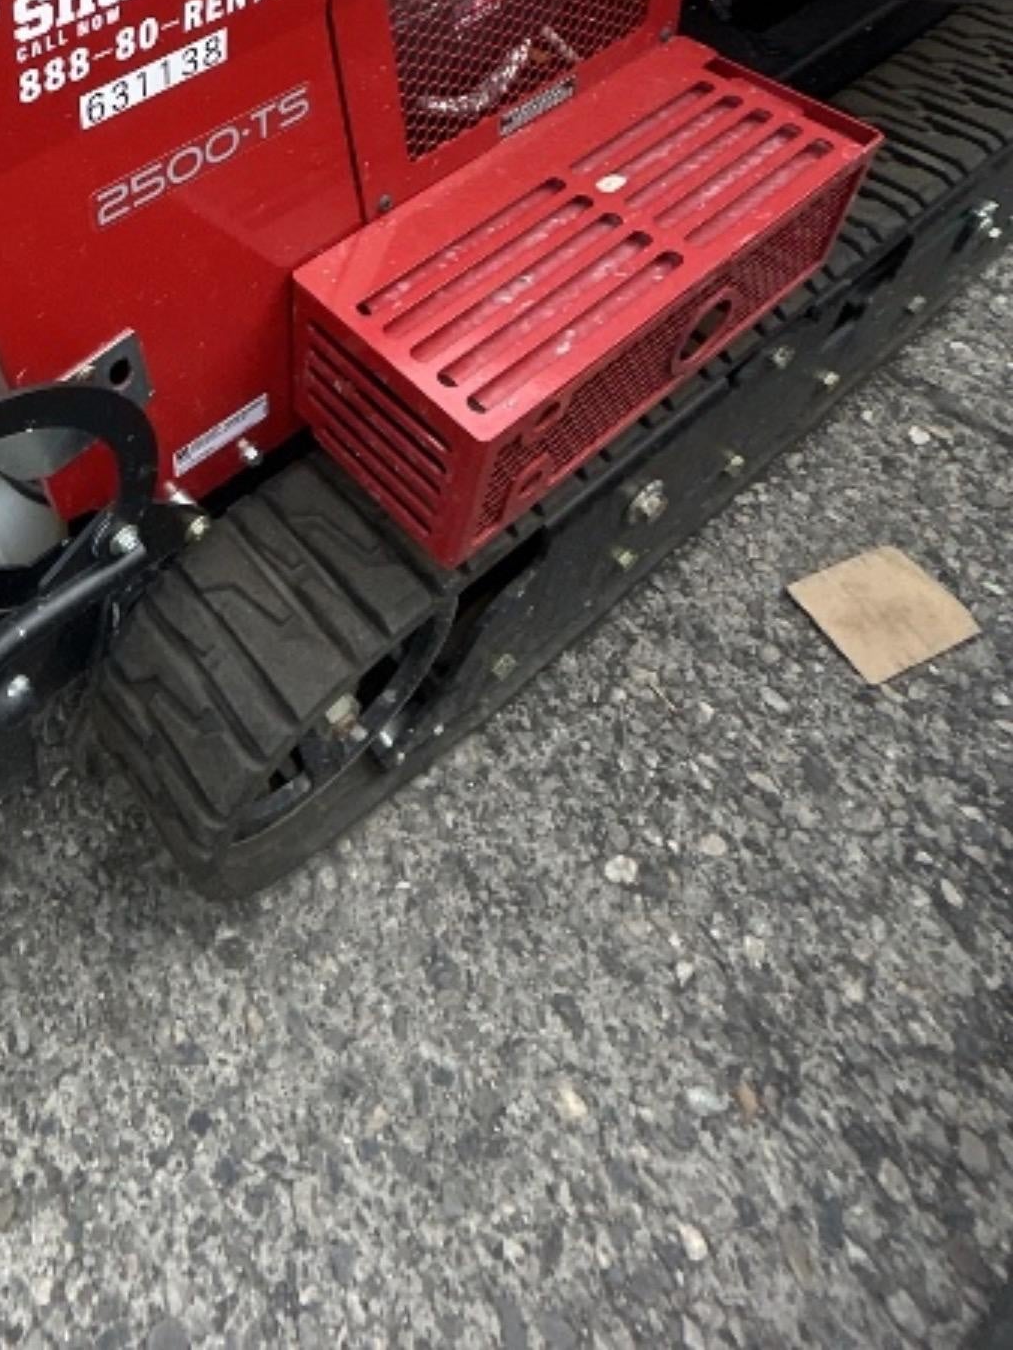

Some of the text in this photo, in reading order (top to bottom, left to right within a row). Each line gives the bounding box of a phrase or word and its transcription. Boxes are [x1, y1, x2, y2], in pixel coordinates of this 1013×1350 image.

[16, 5, 120, 63] CALL NOW
[86, 35, 223, 124] 631138
